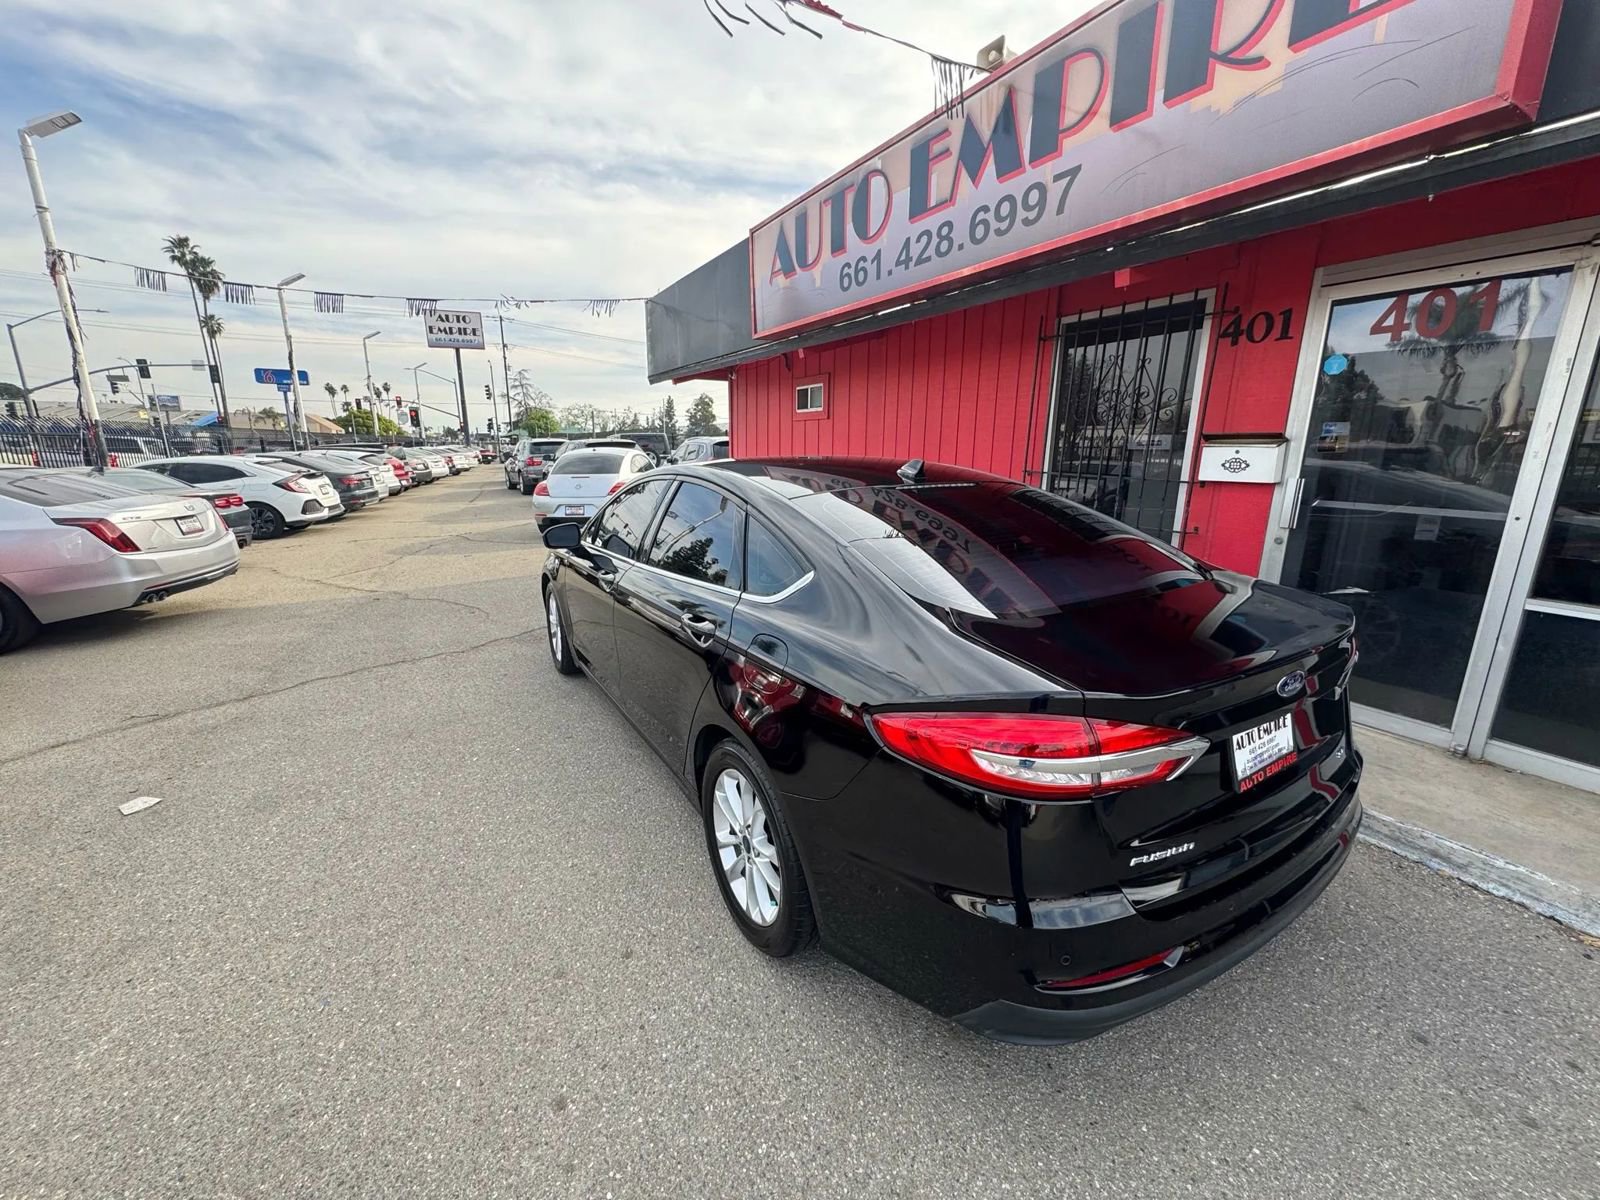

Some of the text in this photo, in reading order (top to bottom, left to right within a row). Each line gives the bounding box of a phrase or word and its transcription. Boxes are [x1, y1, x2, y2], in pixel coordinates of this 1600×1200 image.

[769, 169, 893, 286] AUTO
[839, 163, 1082, 293] 661.428.6997
[428, 325, 480, 336] EMPIRE
[436, 313, 471, 324] AUTO
[1219, 305, 1294, 346] 401
[1369, 279, 1503, 342] 401
[1235, 729, 1257, 751] AUTO
[1240, 770, 1265, 793] AUTO
[1266, 751, 1298, 777] EMPIRE
